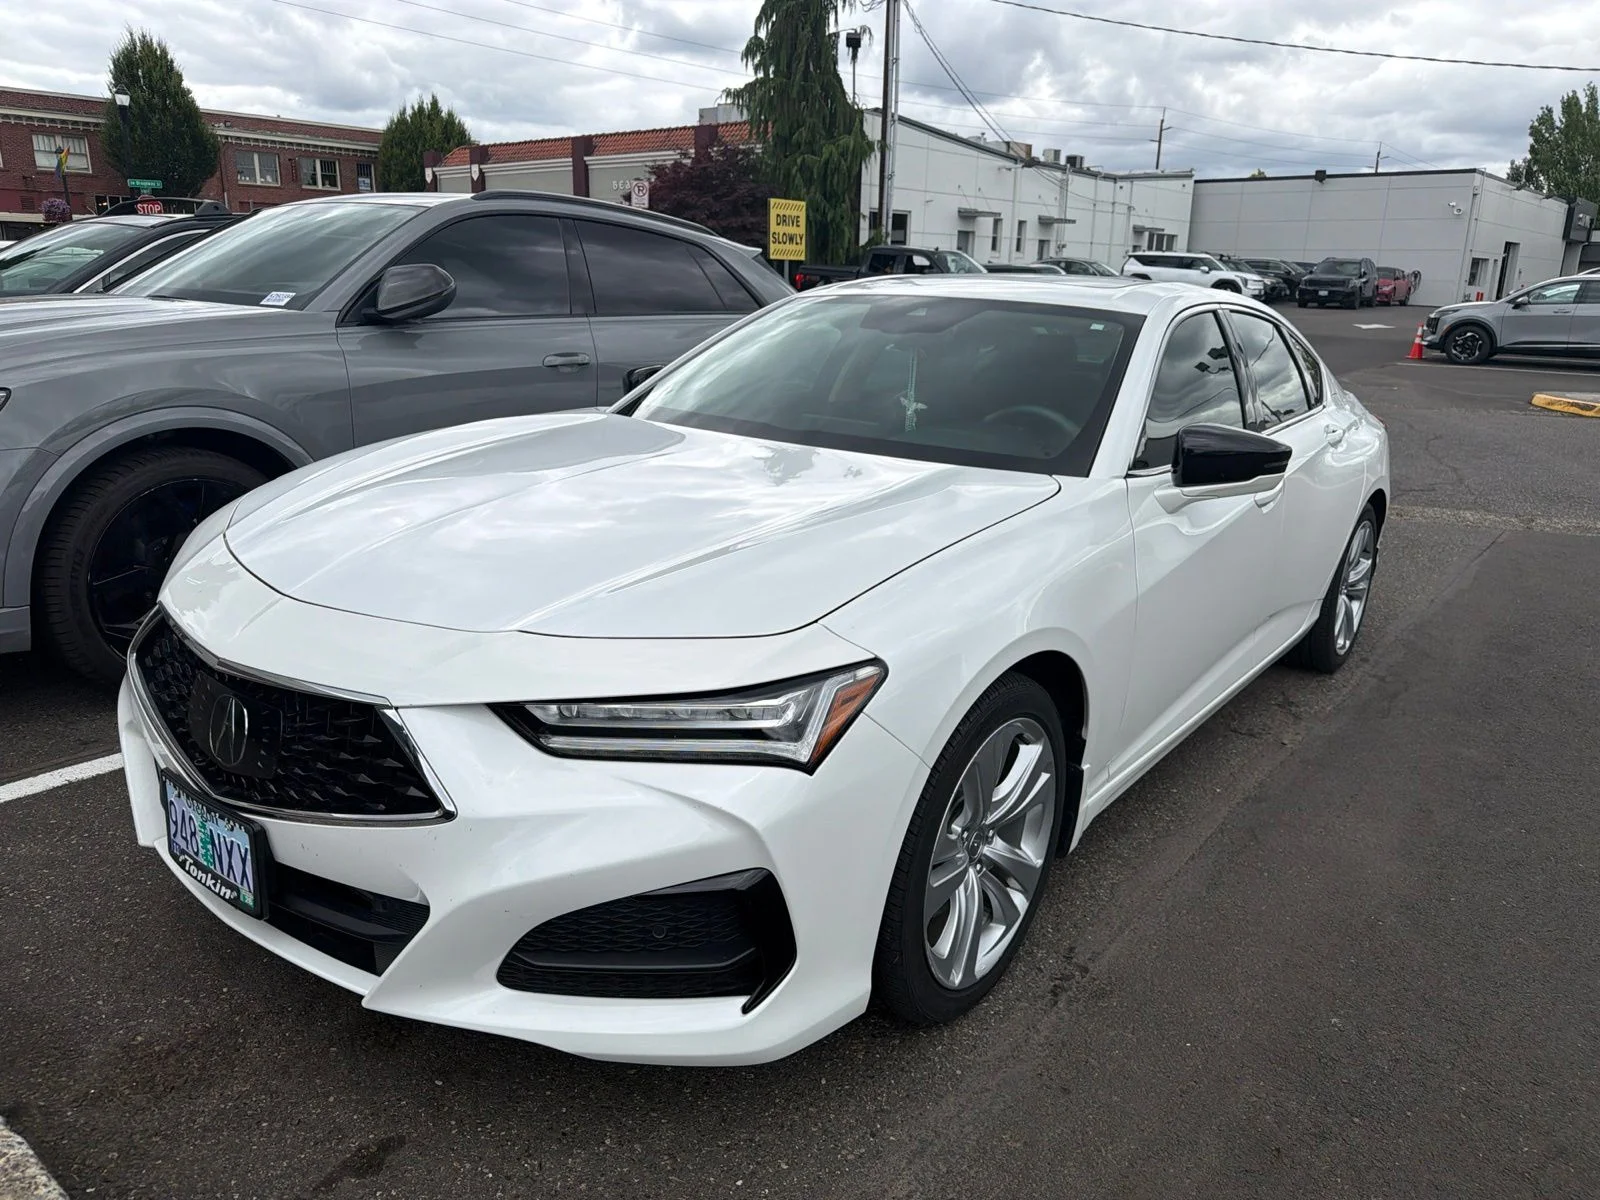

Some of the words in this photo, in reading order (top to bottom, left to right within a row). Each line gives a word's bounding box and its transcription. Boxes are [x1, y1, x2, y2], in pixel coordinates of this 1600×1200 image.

[137, 203, 160, 214] STOP
[776, 213, 800, 227] DRIVE
[772, 232, 804, 245] SLOWLY
[169, 799, 199, 857] 948
[209, 828, 253, 893] NXX
[182, 854, 234, 900] Tonkin
